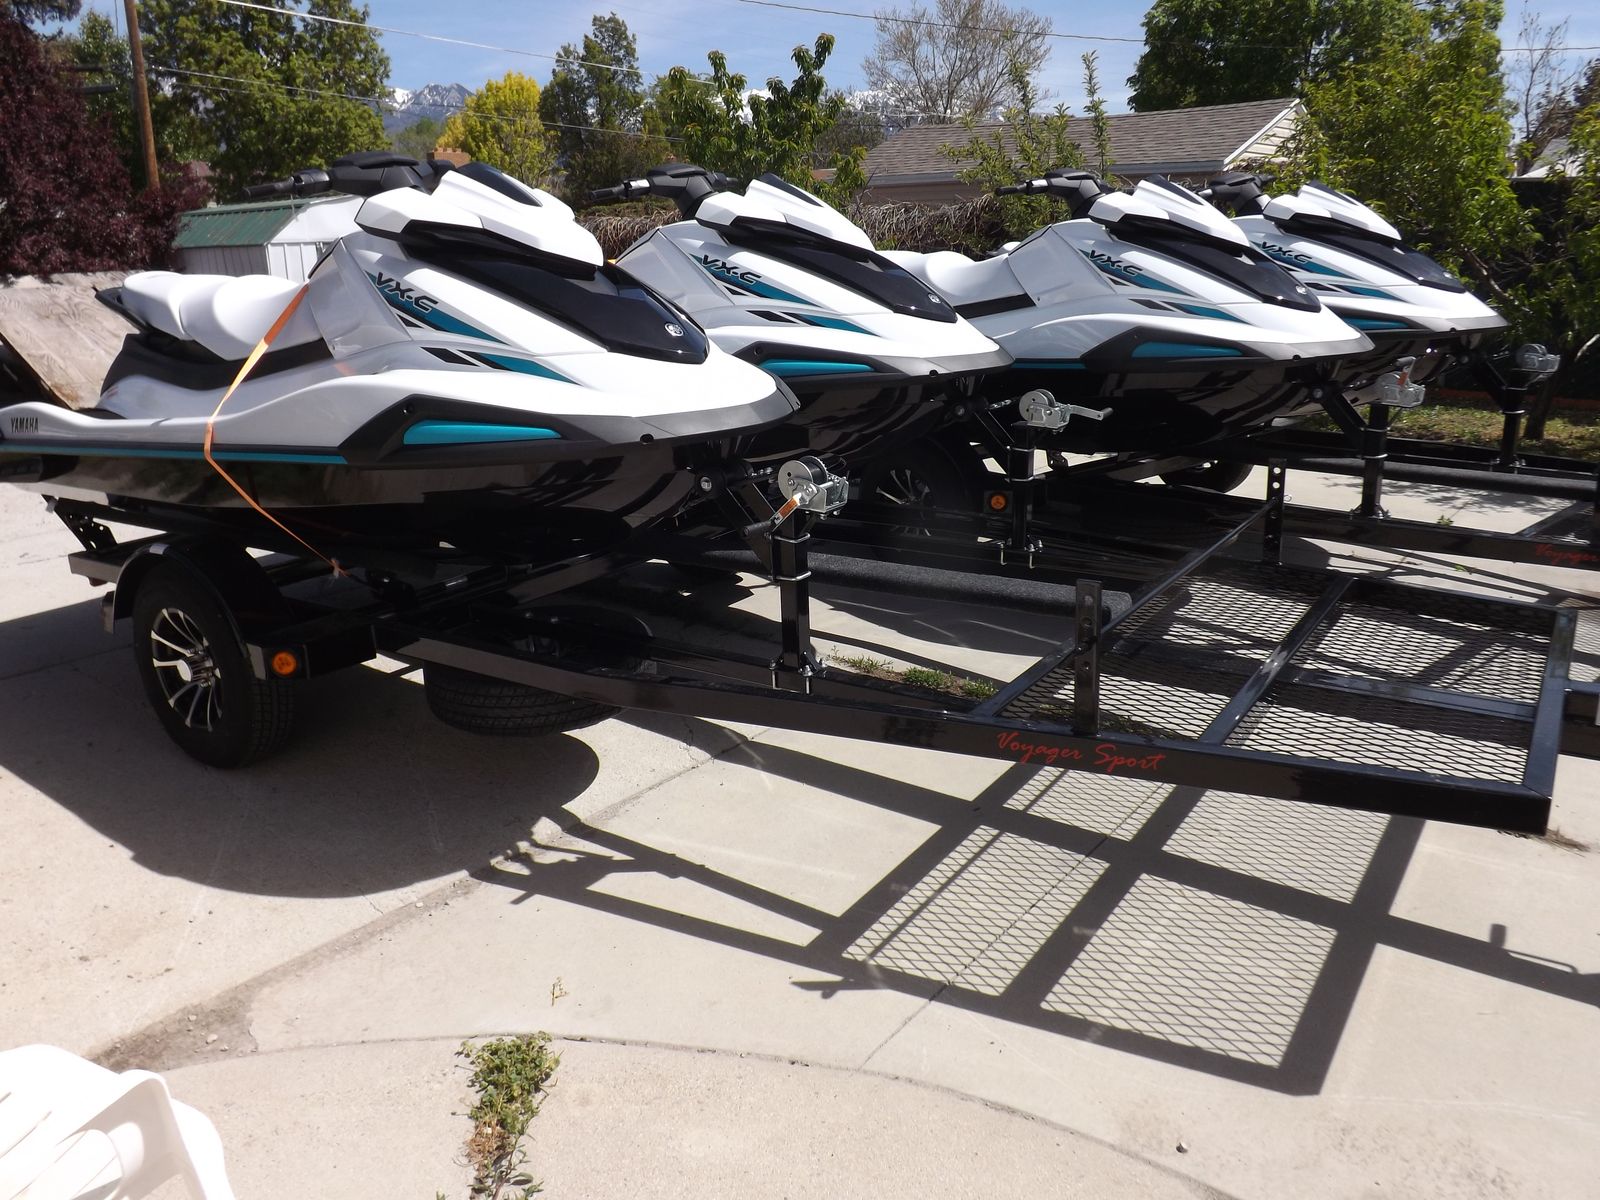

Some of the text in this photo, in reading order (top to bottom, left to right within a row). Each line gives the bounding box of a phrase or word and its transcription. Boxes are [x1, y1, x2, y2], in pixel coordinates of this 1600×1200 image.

[376, 271, 439, 313] VX-C
[10, 416, 39, 433] YAMAHA
[997, 731, 1166, 773] Voyager Sport
